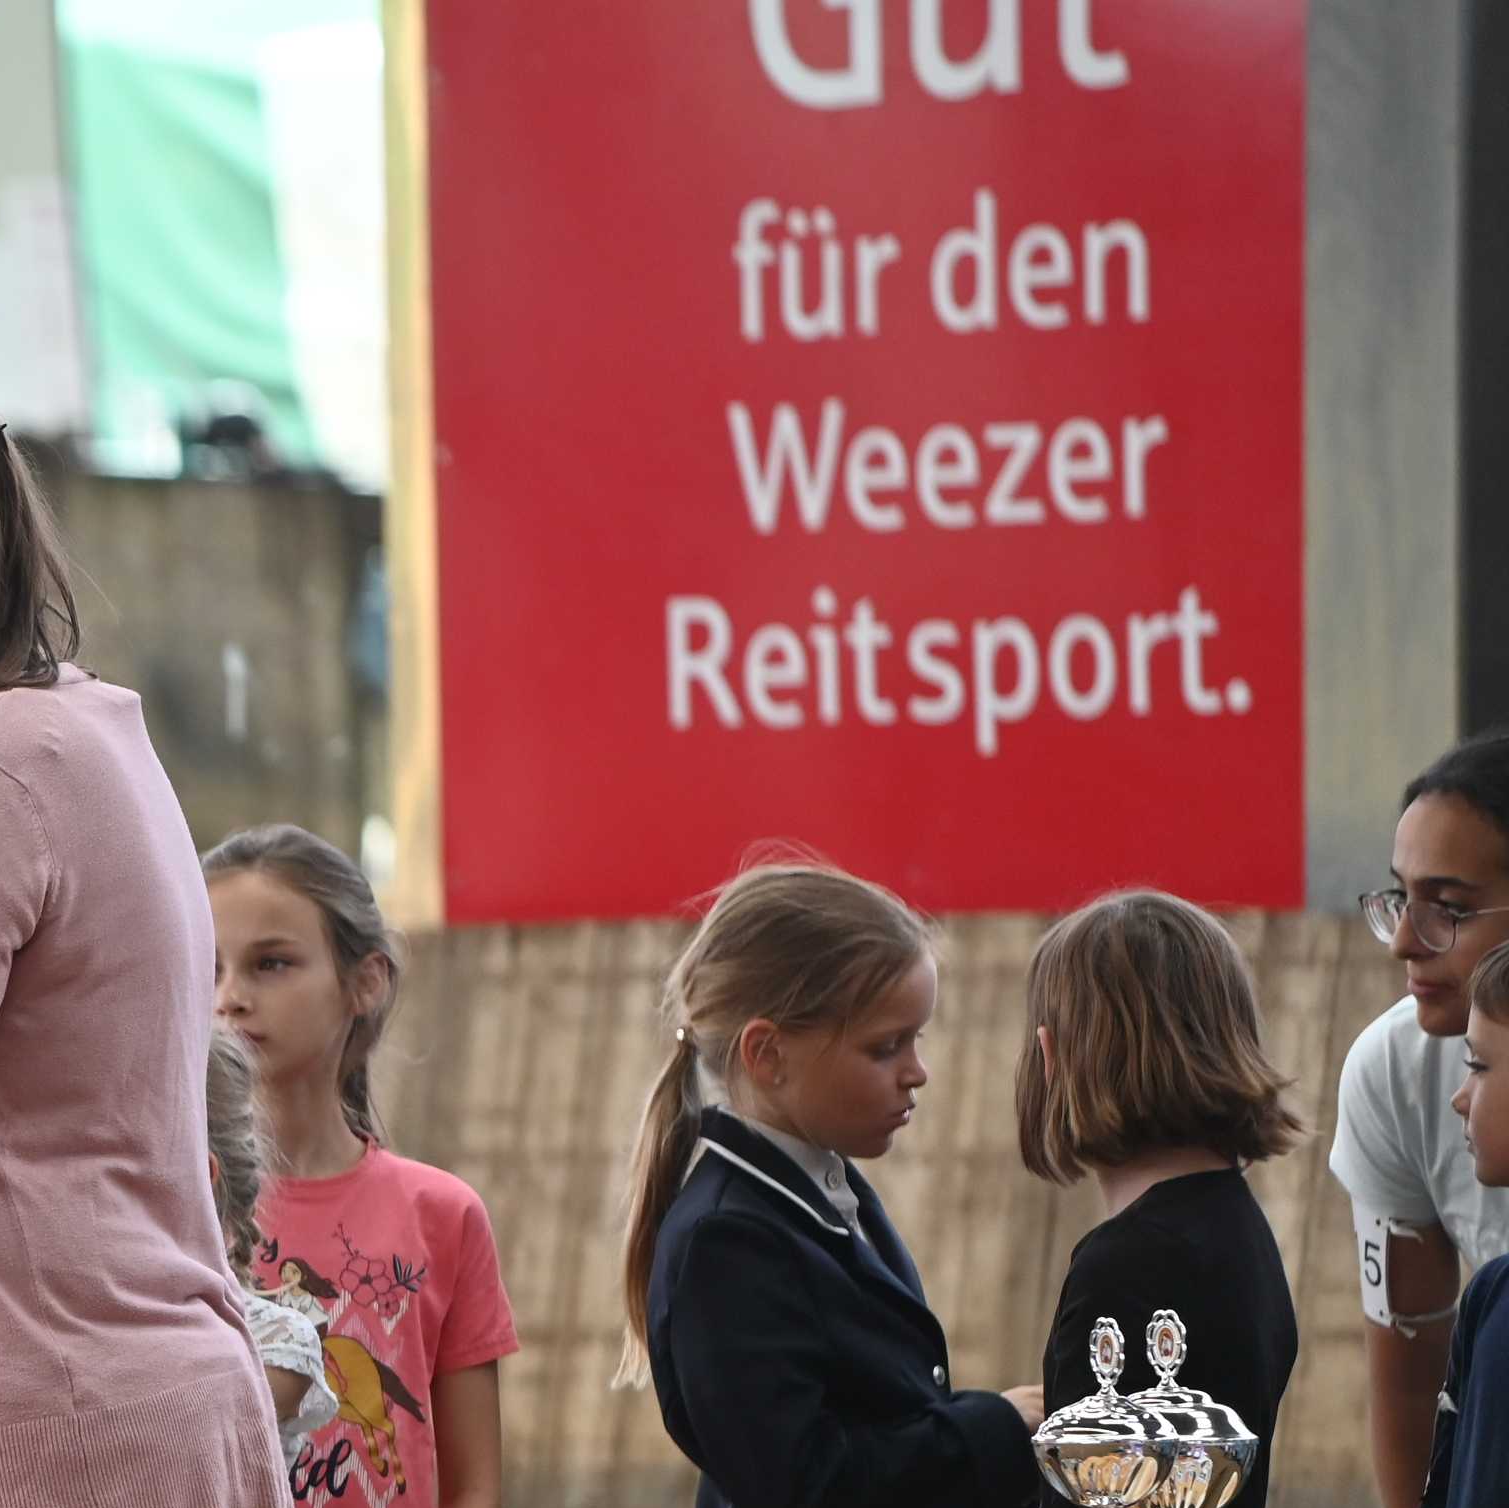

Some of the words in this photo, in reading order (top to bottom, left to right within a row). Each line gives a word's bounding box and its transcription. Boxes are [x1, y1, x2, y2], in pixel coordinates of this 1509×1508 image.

[734, 199, 900, 343] für
[931, 187, 1150, 334] den
[725, 395, 1168, 535] Weezer
[664, 583, 1252, 757] Reitsport.
[1364, 1239, 1382, 1287] 5
